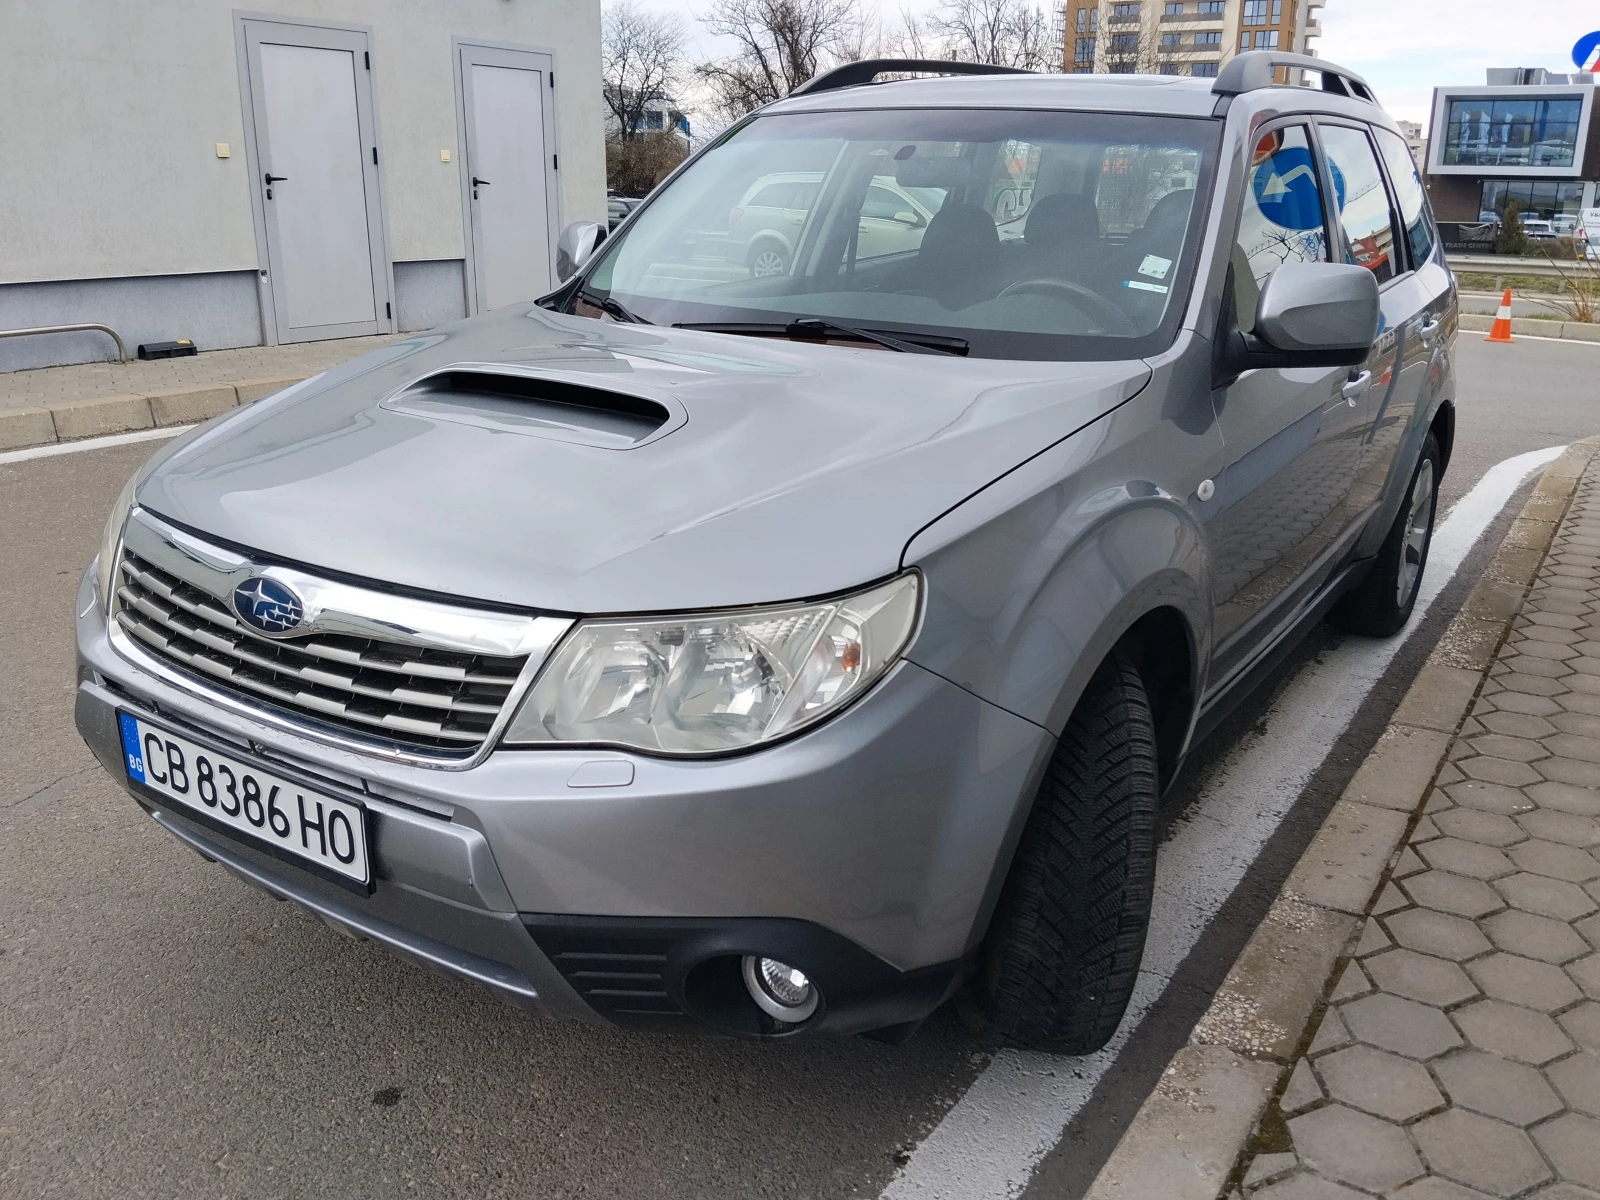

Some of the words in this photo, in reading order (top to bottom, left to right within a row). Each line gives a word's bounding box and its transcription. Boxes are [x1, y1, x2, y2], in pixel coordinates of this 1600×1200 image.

[129, 753, 143, 773] BG
[144, 732, 190, 795] CB
[195, 755, 291, 839] 8386
[296, 794, 356, 865] HO
